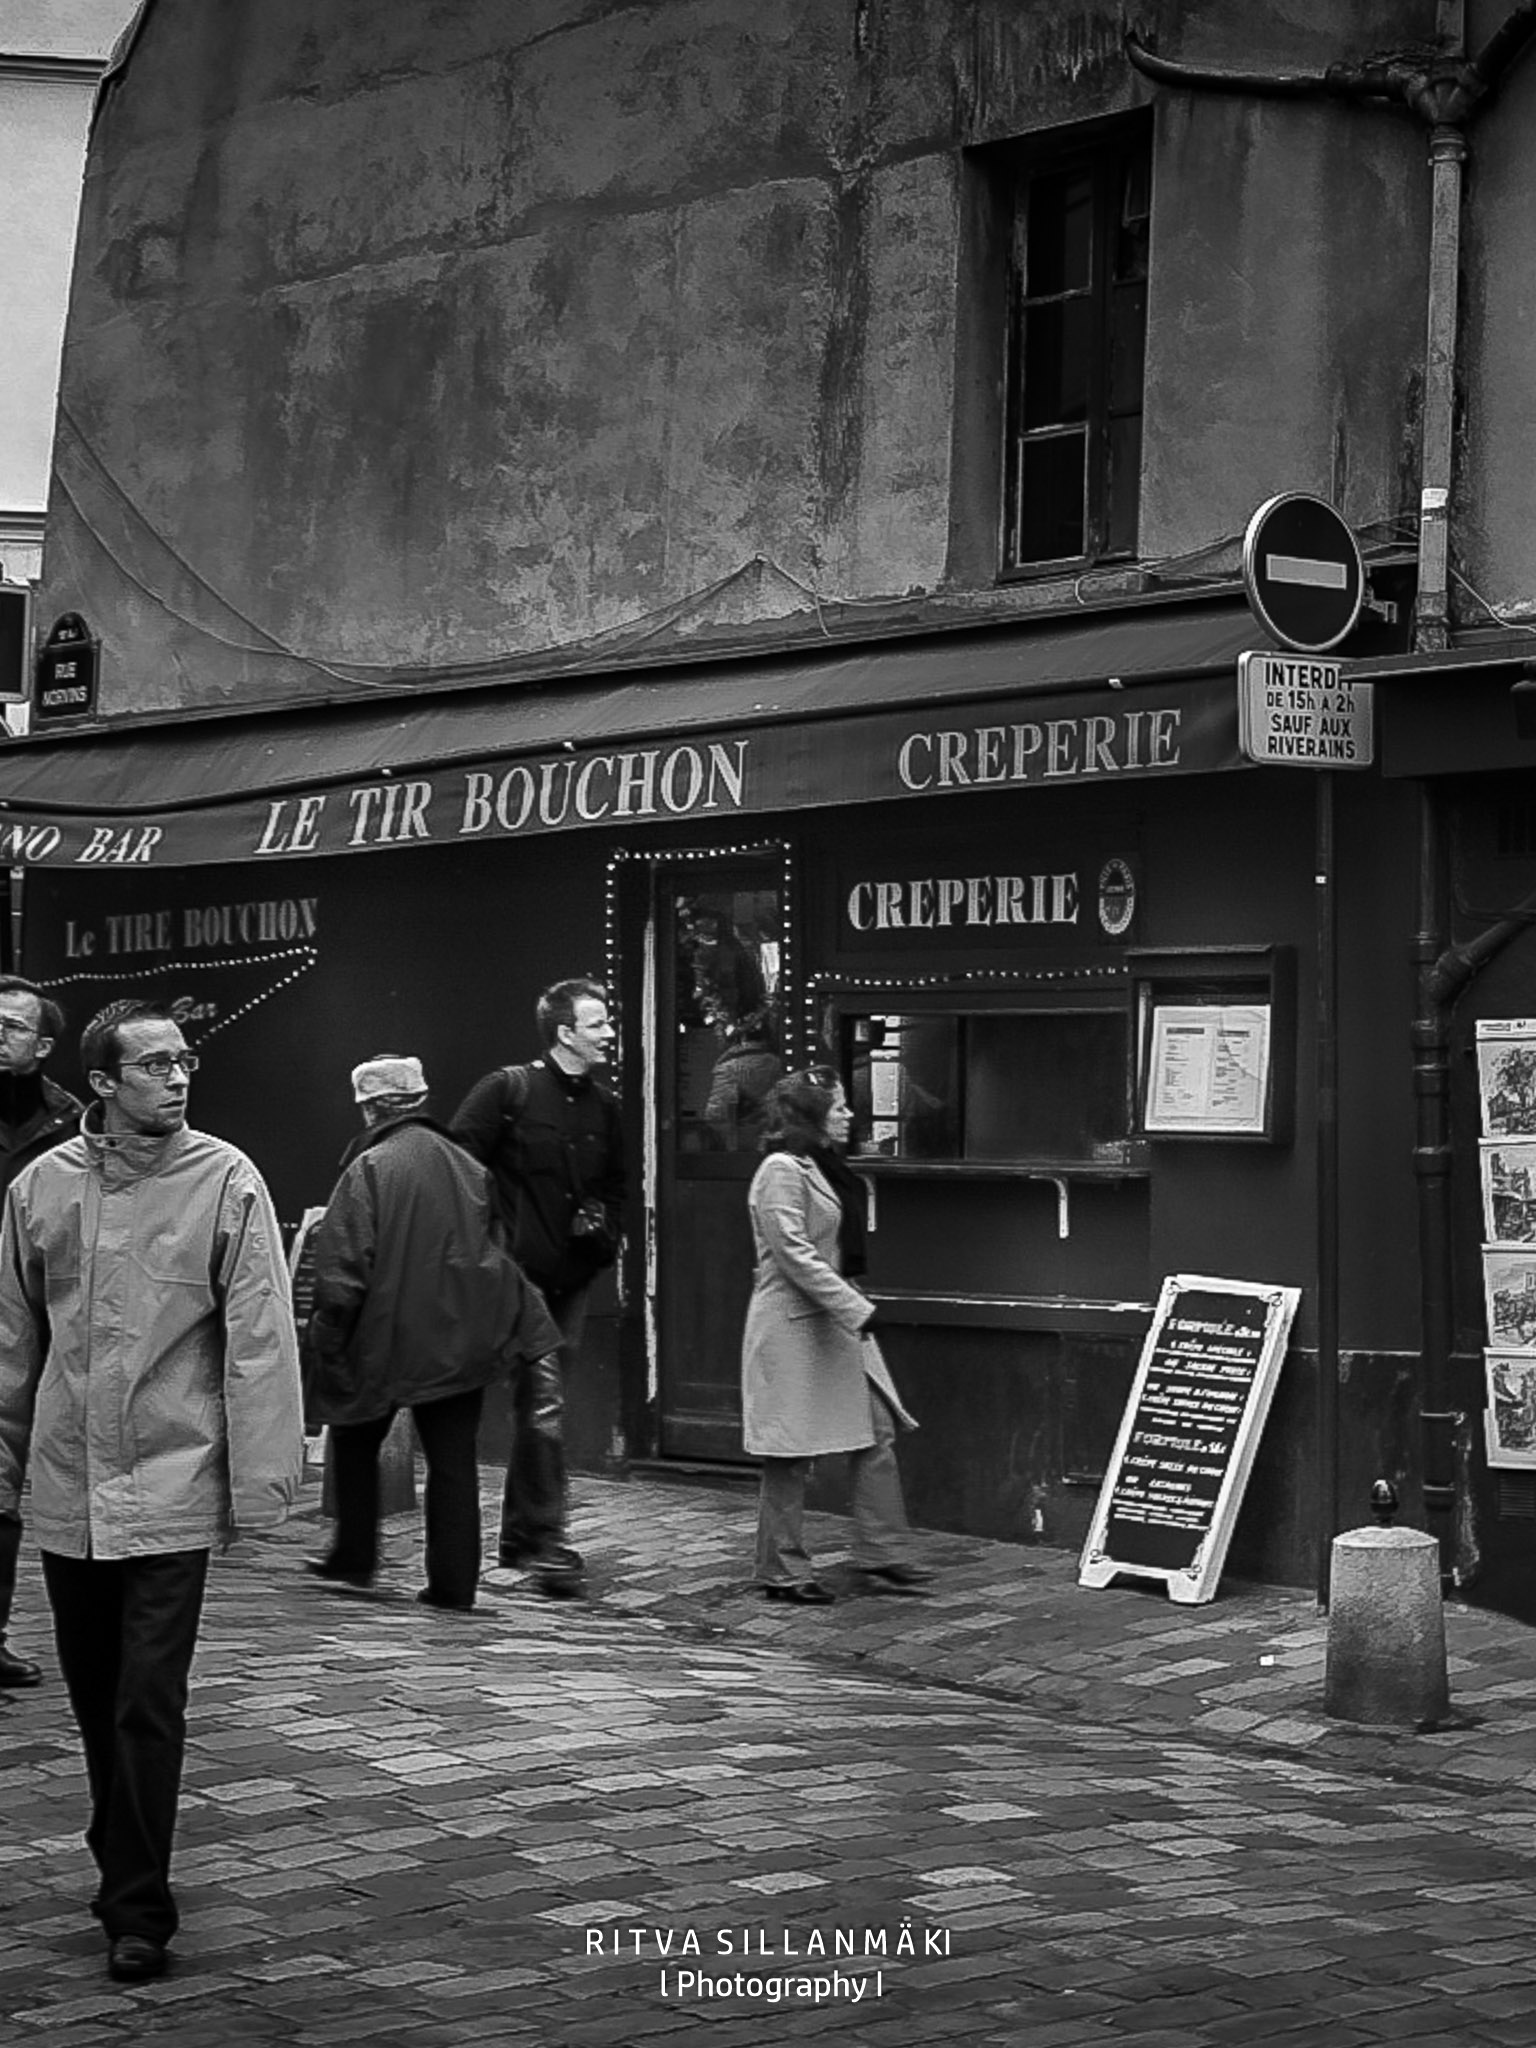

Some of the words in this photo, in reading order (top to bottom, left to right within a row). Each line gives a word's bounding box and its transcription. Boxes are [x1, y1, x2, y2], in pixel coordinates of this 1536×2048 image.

[1267, 691, 1284, 707] DE
[1288, 690, 1315, 710] 15h
[1336, 693, 1355, 713] 2h
[1271, 713, 1312, 735] SAUF
[1319, 717, 1352, 738] AUX
[898, 709, 1182, 790] CREPERIE
[1267, 735, 1356, 759] RIVERAINS
[253, 796, 326, 854] LE
[348, 781, 432, 845] TIR
[459, 740, 749, 834] BOUCHON
[0, 824, 61, 861] NO
[74, 826, 163, 863] BAR
[848, 872, 1080, 931] CREPERIE
[65, 920, 97, 957] Le
[105, 910, 172, 954] TIRE
[184, 898, 318, 948] BOUCHON
